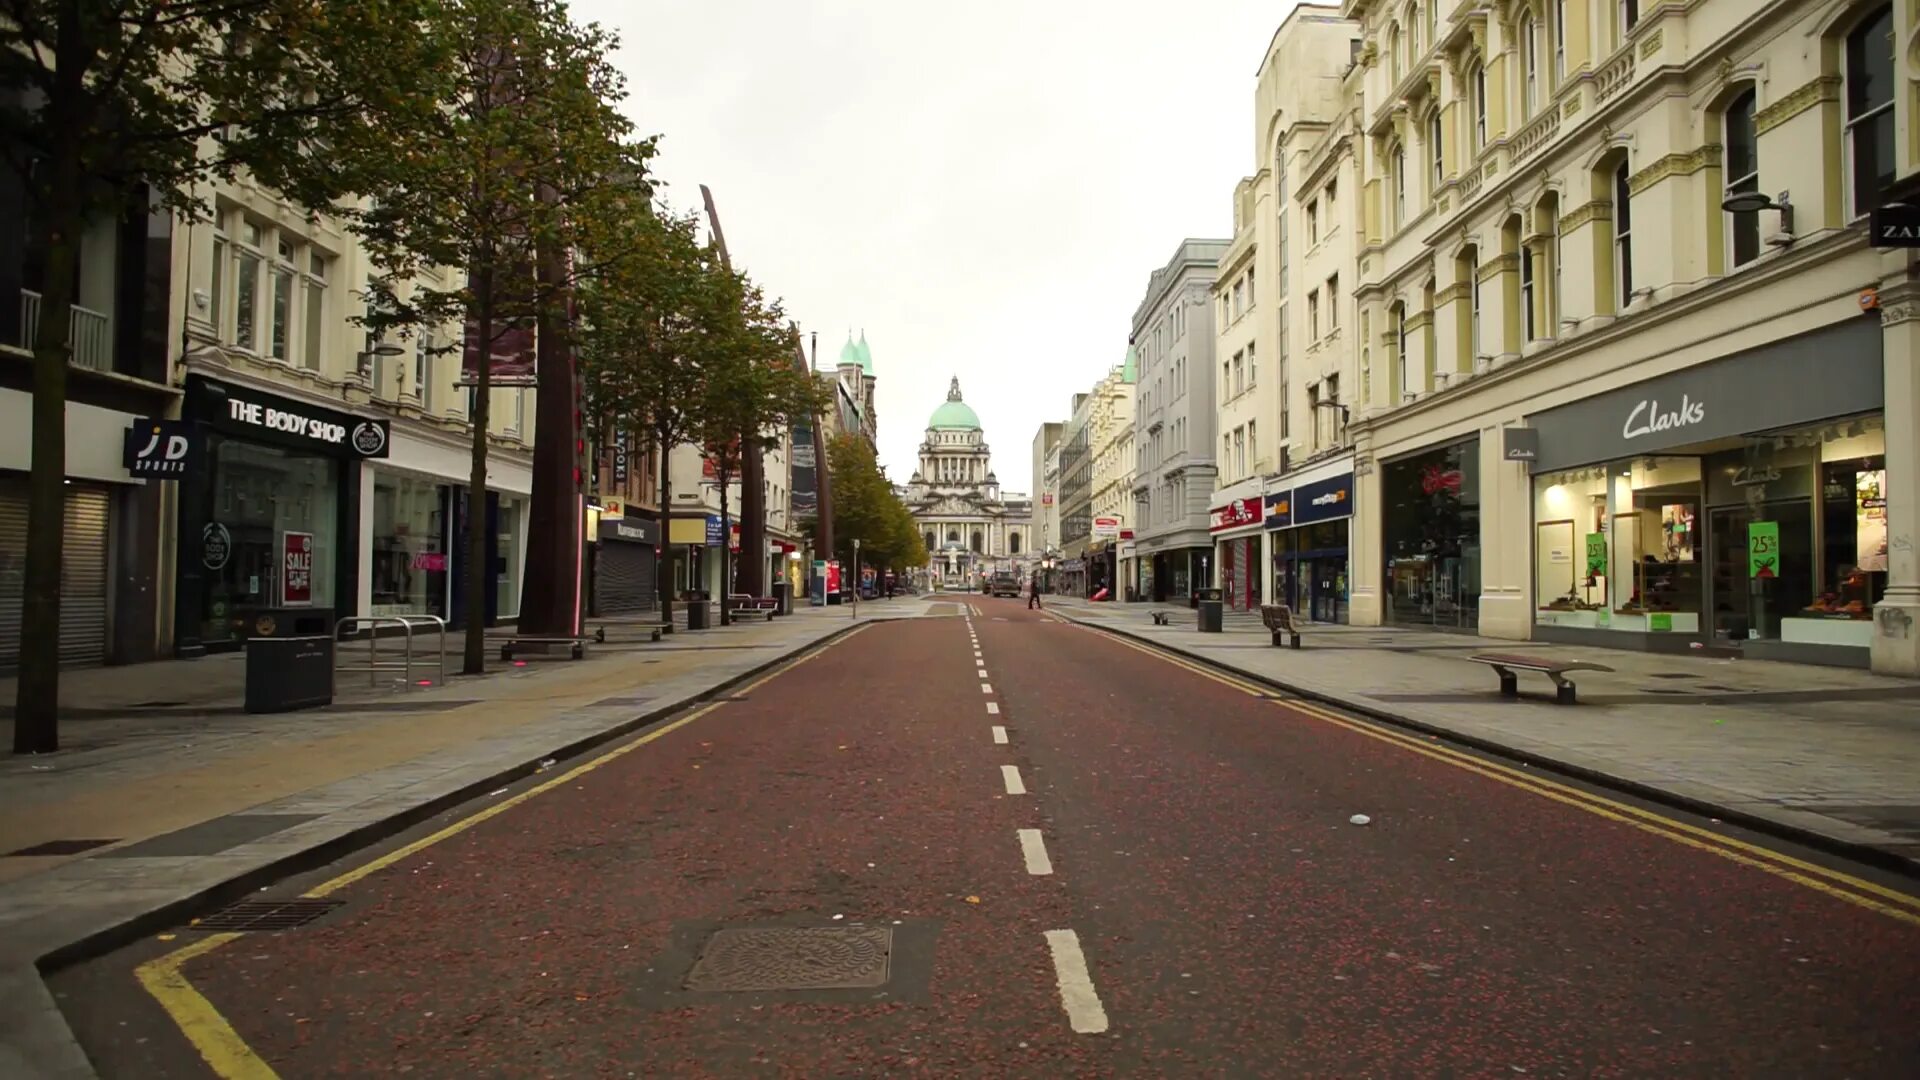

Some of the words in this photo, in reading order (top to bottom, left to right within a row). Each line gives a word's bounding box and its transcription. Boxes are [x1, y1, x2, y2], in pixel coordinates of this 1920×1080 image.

[1883, 226, 1920, 238] ZA
[228, 398, 262, 425] THE
[265, 408, 311, 435] BODY
[309, 419, 346, 444] SHOP
[1623, 394, 1704, 439] Clarks
[138, 426, 189, 460] JD
[136, 460, 186, 473] SPORTS
[287, 552, 310, 570] SALE
